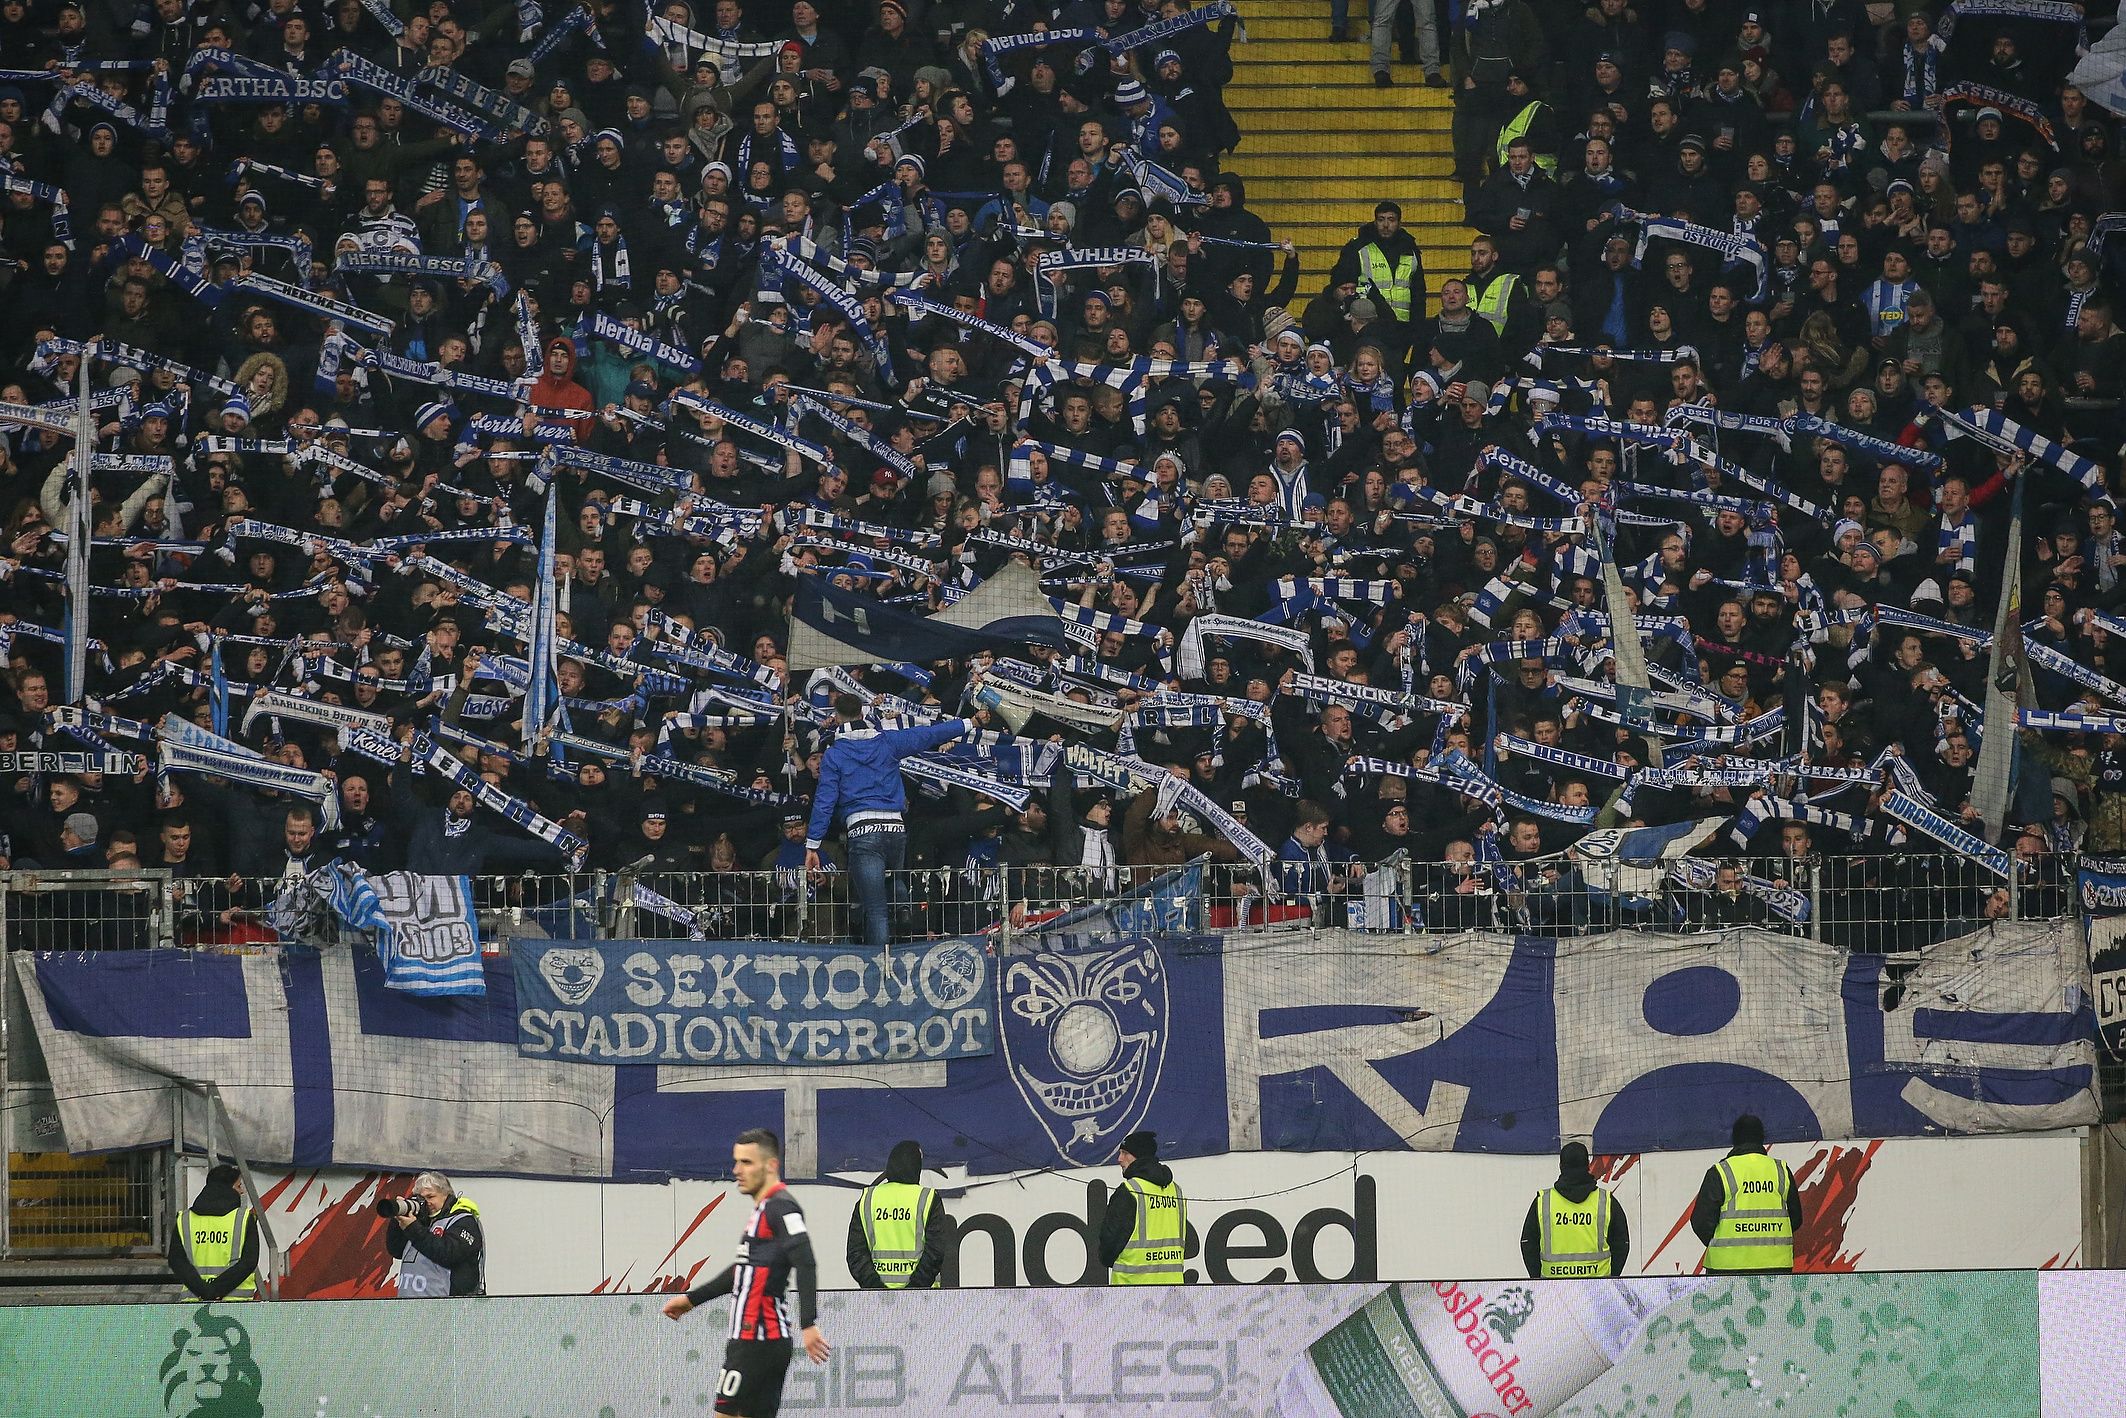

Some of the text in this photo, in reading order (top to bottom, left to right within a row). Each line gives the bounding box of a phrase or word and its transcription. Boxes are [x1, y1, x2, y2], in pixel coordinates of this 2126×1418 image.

[196, 77, 343, 101] ERTHA BSC
[1682, 230, 1741, 258] OSTKURVE
[347, 254, 466, 273] HERTHA BSC
[1038, 252, 1066, 267] BS
[773, 247, 868, 326] STAMMGAST
[281, 280, 375, 322] HERTHA BSC
[2062, 290, 2083, 328] HERTHA
[593, 313, 692, 369] Hertha BSC
[456, 378, 508, 395] BSC
[1583, 417, 1622, 434] BSC
[1551, 483, 1584, 507] BS
[650, 606, 778, 683] BERLI
[1295, 675, 1397, 705] SEKTION
[269, 696, 331, 719] HARLEKINS
[333, 708, 370, 728] BERLIN
[352, 731, 401, 762] Karls
[0, 752, 140, 775] BERLIN
[172, 750, 282, 785] HAUPTSTADTMAFIA
[1065, 743, 1123, 783] HALTET
[1103, 753, 1151, 777] Berliner
[1534, 748, 1619, 778] HERTHA
[1799, 765, 1872, 780] GERADE
[416, 738, 584, 855] BERLIN
[1207, 807, 1230, 832] BSC
[1227, 825, 1265, 858] BERLIN
[1886, 791, 1982, 859] DURCHHALTEN
[622, 946, 922, 1010] SEKTION
[520, 1008, 988, 1062] STADIONVERBOT
[1742, 1180, 1775, 1194] 20040
[875, 1206, 912, 1221] 26-036
[1149, 1195, 1177, 1210] 26-006
[943, 1172, 1378, 1287] nded
[1555, 1211, 1593, 1226] 26-020
[1734, 1221, 1784, 1233] SECURITY
[194, 1230, 230, 1245] 32-005
[873, 1260, 916, 1273] SECURITY
[1145, 1250, 1182, 1261] SECURIT
[1549, 1264, 1599, 1275] SECURITY
[399, 1272, 427, 1292] TO
[1430, 1280, 1535, 1418] osbacher
[715, 1368, 743, 1397] 10
[779, 1345, 904, 1408] GIB
[949, 1338, 1240, 1405] ALLES!
